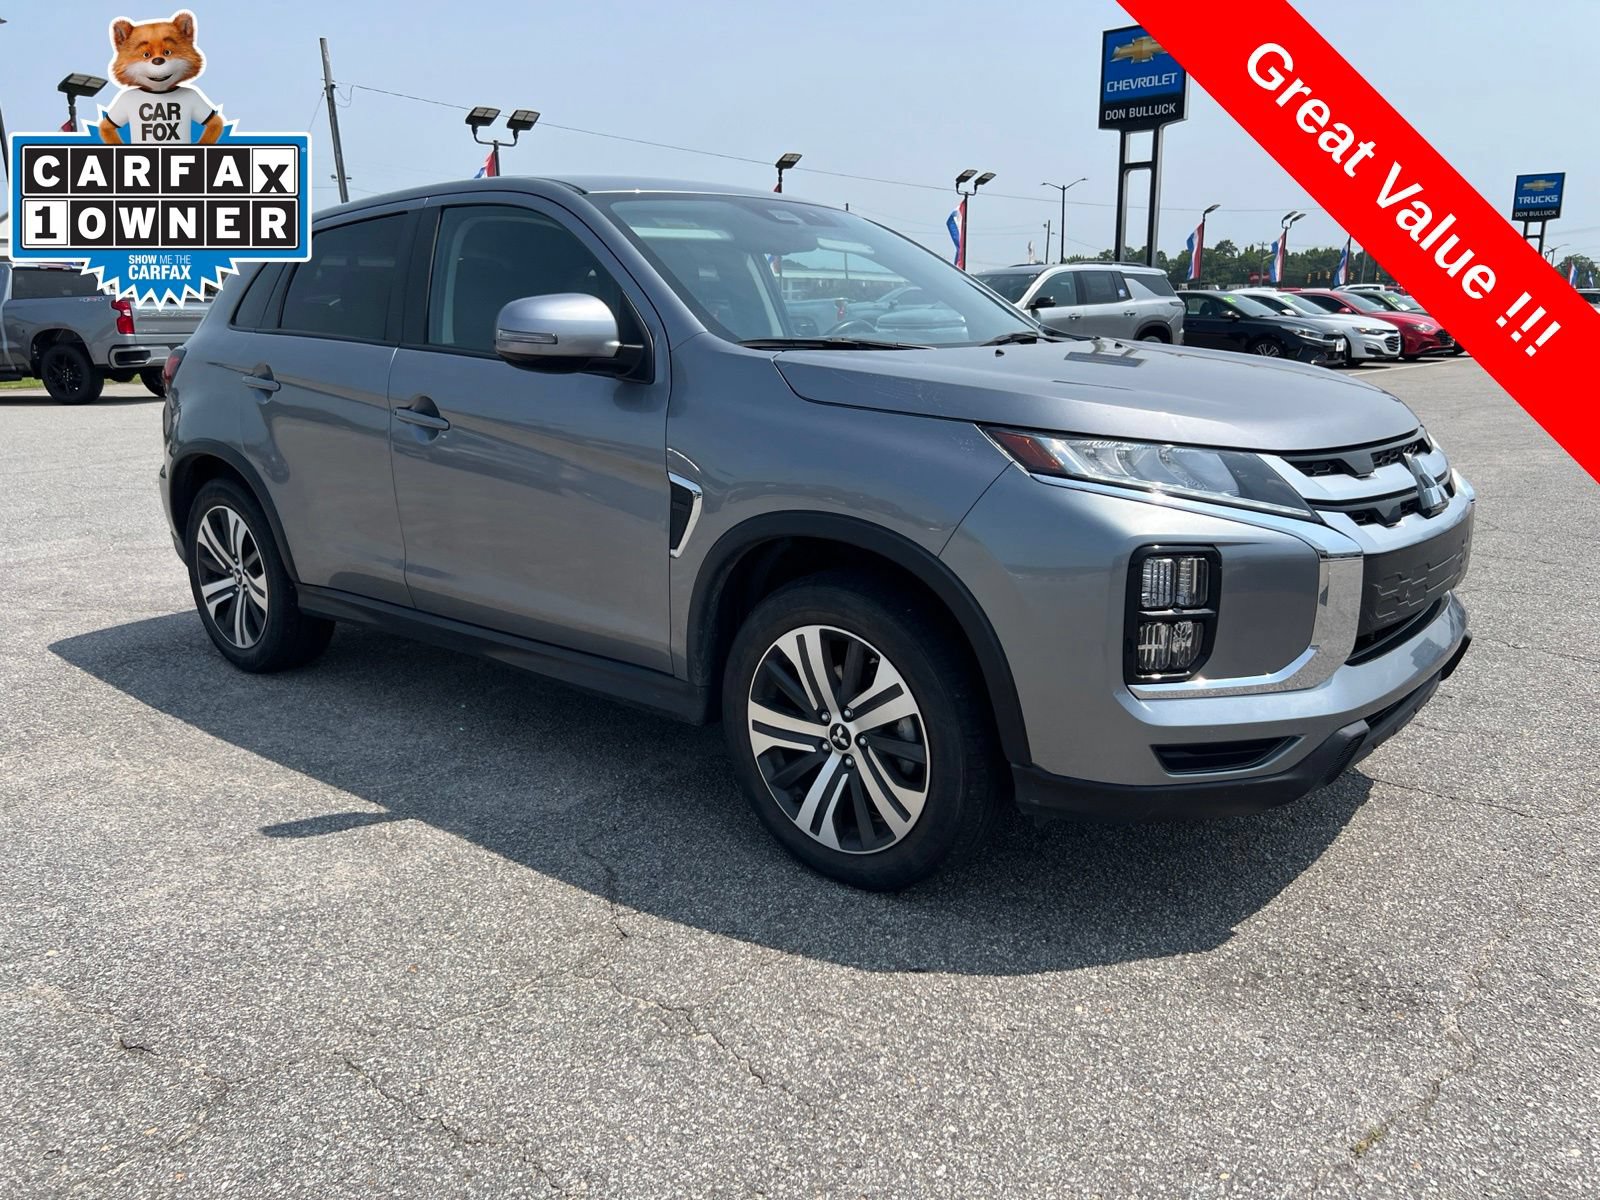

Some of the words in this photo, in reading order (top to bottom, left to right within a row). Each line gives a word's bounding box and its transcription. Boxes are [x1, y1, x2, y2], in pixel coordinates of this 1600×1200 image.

[1106, 72, 1178, 93] CHEVROLET
[1105, 108, 1126, 121] DON
[1129, 102, 1177, 118] BULLUCK
[1517, 194, 1559, 204] TRUCKS
[1515, 210, 1528, 218] DON
[1529, 209, 1557, 217] BULLUCK
